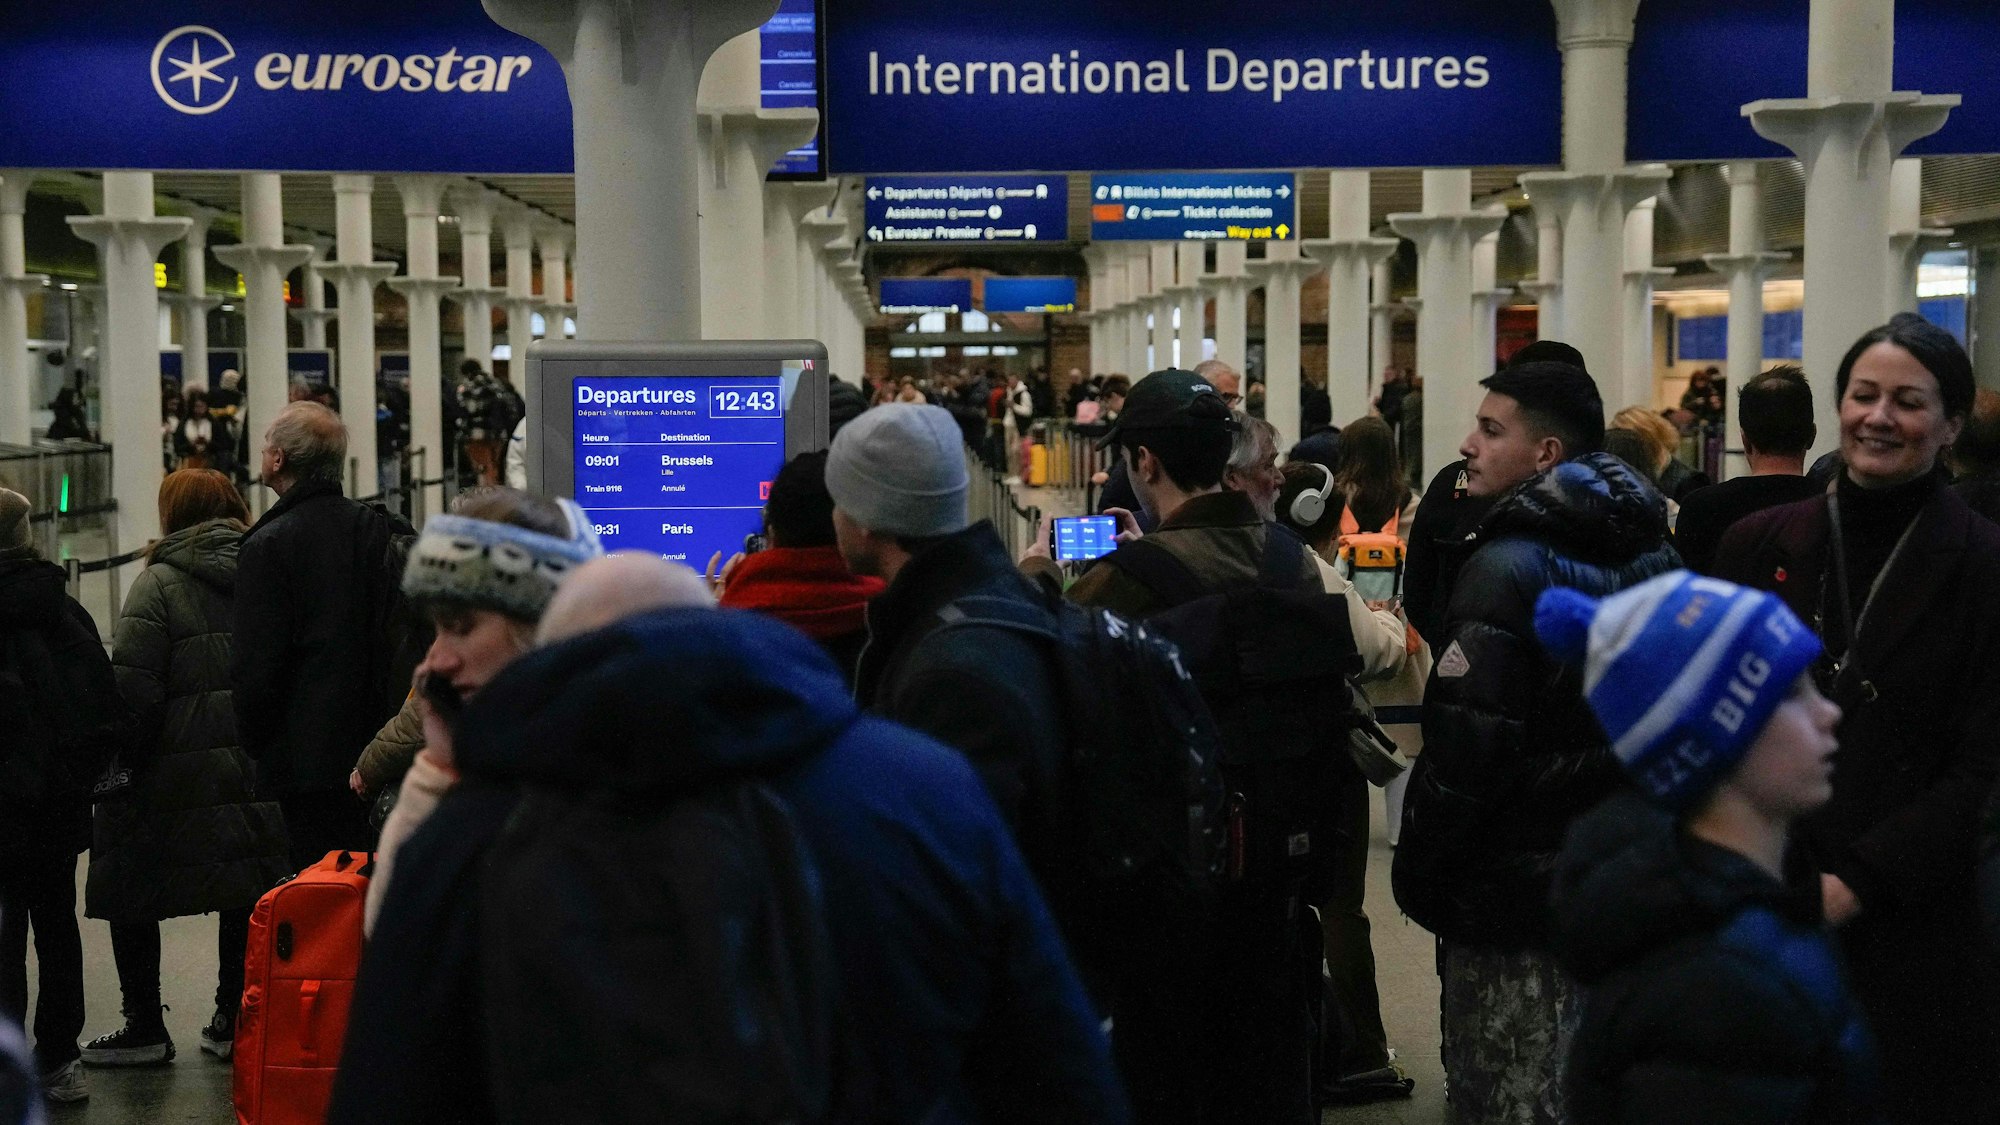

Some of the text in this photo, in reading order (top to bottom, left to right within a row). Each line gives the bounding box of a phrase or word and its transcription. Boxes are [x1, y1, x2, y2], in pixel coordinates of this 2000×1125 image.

[254, 46, 533, 92] eurostar
[869, 48, 1490, 103] International Departures
[884, 187, 948, 202] Departures
[949, 186, 994, 202] Départs
[1123, 186, 1273, 199] Billets International tickets
[885, 206, 947, 219] Assistance
[1182, 206, 1217, 218] Ticket
[1218, 206, 1273, 218] collection
[885, 226, 934, 239] Eurostar
[935, 226, 982, 239] Premier
[1227, 226, 1252, 239] Way
[1252, 226, 1272, 238] out
[577, 385, 697, 408] Departures
[715, 391, 776, 411] 12:43
[578, 409, 607, 417] Départs
[582, 433, 711, 442] Heure Destination
[585, 454, 714, 467] 09:01 Brussels
[585, 485, 605, 493] Train
[605, 485, 623, 493] 9116
[661, 523, 694, 535] Paris
[661, 552, 687, 560] Annulé
[1710, 652, 1771, 735] BIG
